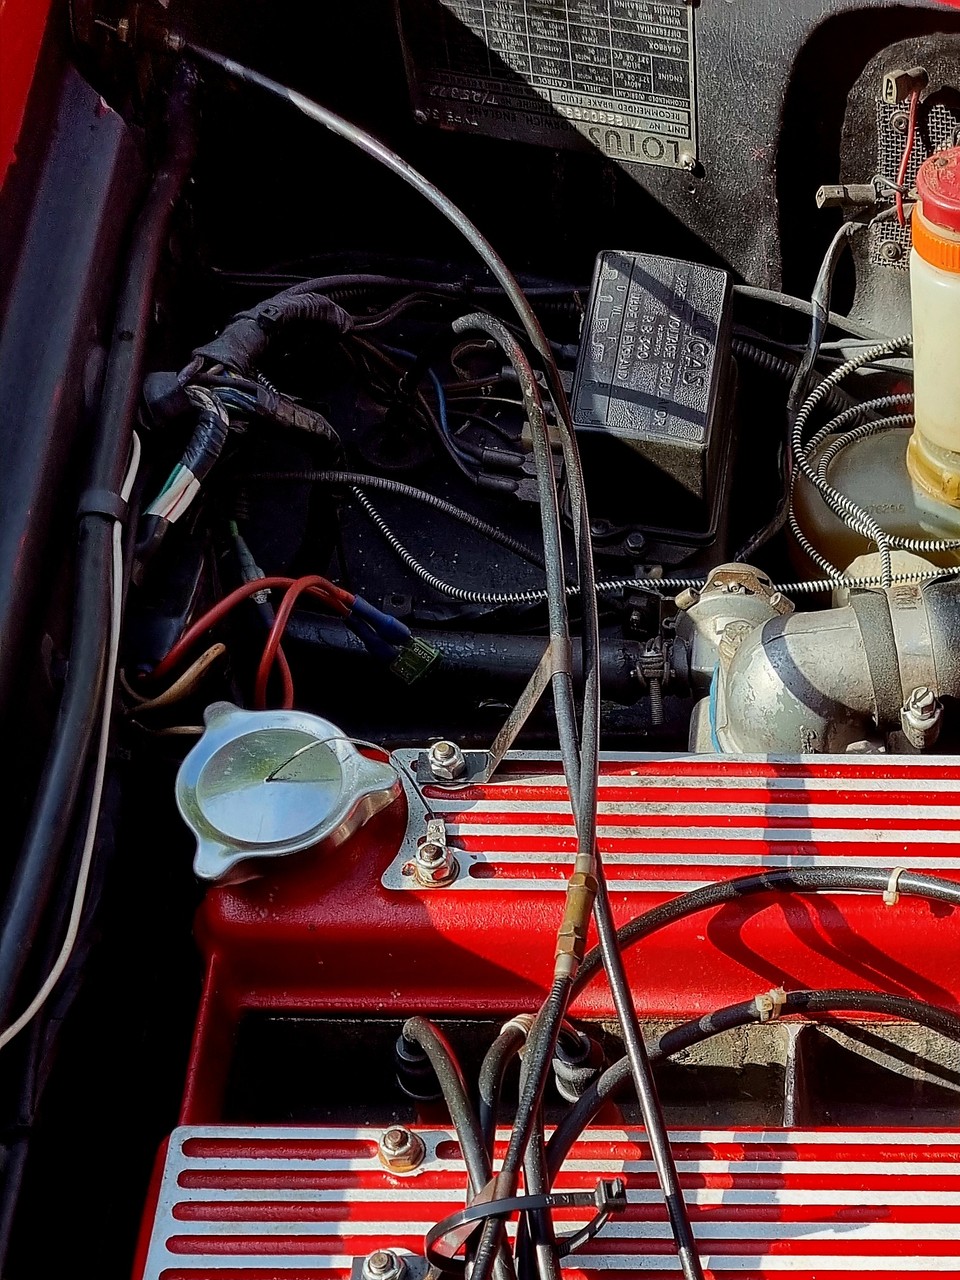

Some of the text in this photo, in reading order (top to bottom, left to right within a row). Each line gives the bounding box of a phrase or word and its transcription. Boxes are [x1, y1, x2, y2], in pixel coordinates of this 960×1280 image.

[537, 77, 567, 88] CASTROL
[657, 73, 683, 83] ENGINE
[582, 84, 602, 93] SHELL
[560, 94, 680, 120] RECOMMENDED BRAKE FLUID
[648, 95, 689, 108] RECOMMENDED
[667, 125, 687, 135] UNIT
[588, 127, 679, 164] LOTUS
[626, 294, 642, 318] MADE
[682, 310, 715, 387] LUCAS
[617, 335, 635, 381] ENGLAND
[413, 644, 432, 662] BUSS
